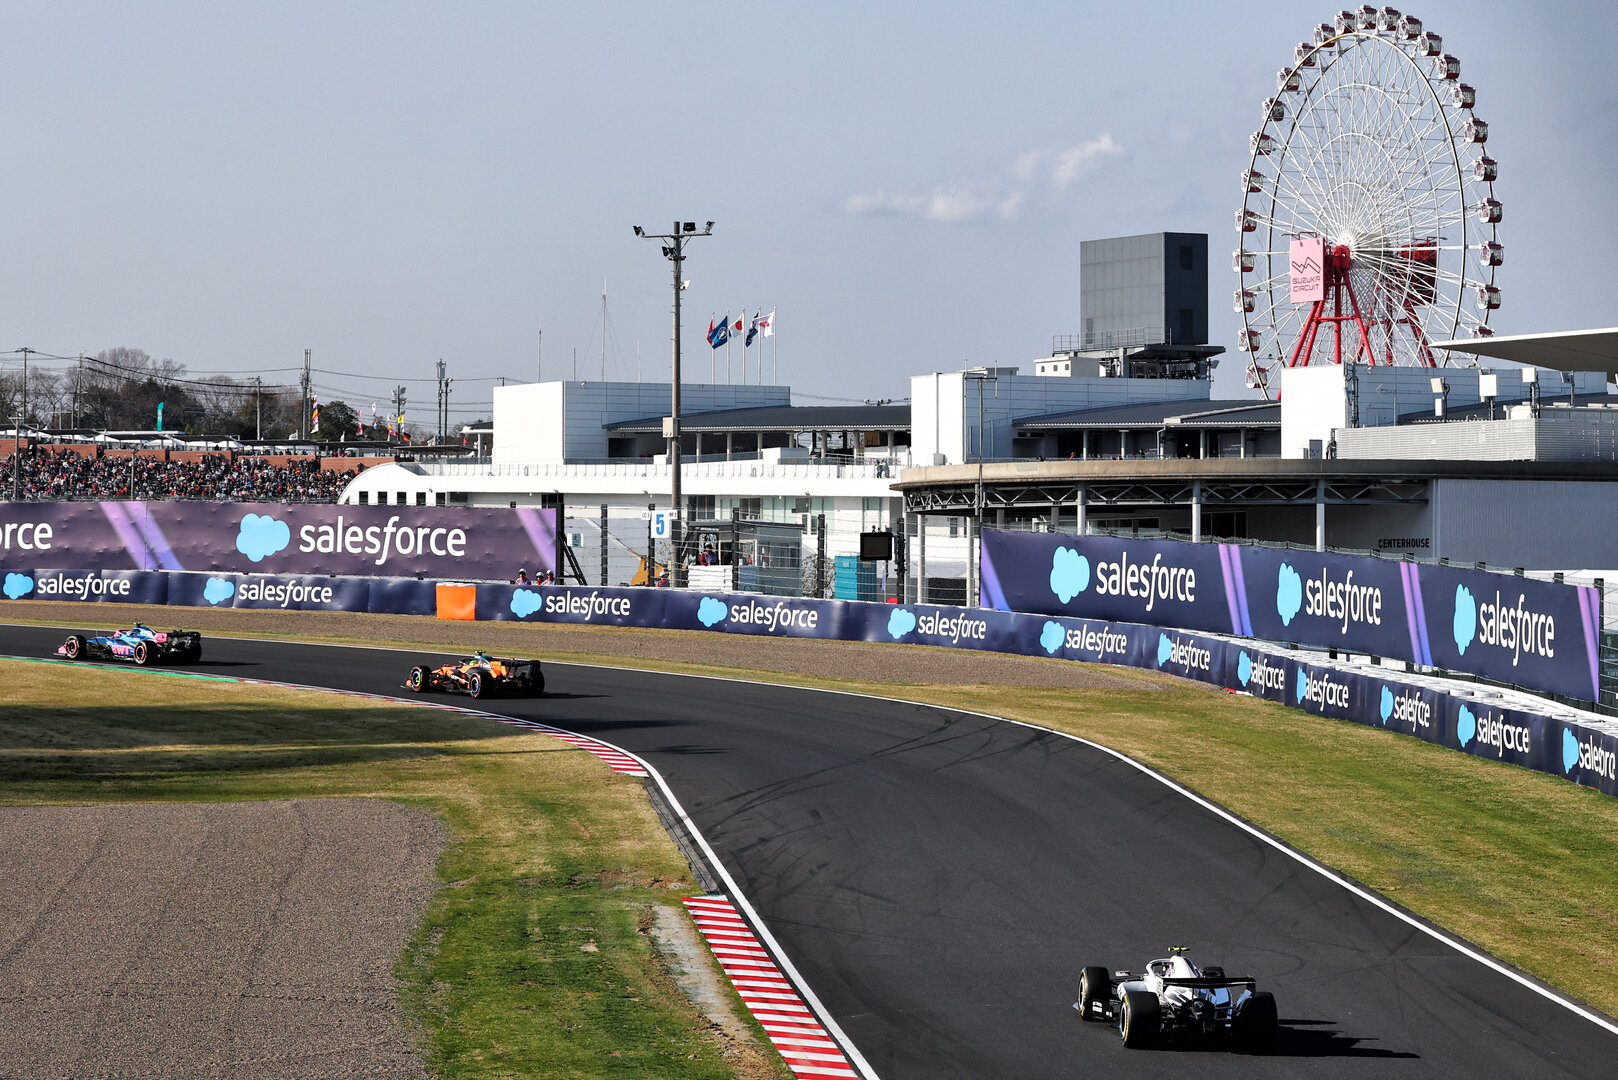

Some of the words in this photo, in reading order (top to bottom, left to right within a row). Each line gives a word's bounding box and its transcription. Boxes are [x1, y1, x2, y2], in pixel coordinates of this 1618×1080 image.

[1292, 275, 1321, 285] SUZUKA
[1292, 284, 1320, 292] CIRCUIT
[0, 522, 53, 550] rce
[655, 513, 665, 535] 5
[298, 515, 468, 567] salesforce
[1377, 537, 1430, 549] CENTERHOUSE
[37, 573, 131, 601] salesforce
[238, 578, 333, 608] salesforce
[1094, 550, 1197, 613] salesforce
[545, 590, 632, 621] salesforce
[730, 597, 818, 632] salesforce
[1304, 566, 1383, 636] salesforce
[917, 610, 987, 645] salesforce
[1065, 621, 1128, 656] salesforce
[1478, 589, 1556, 667] salesforce
[111, 644, 130, 656] BWT
[1476, 710, 1530, 758] salesforce
